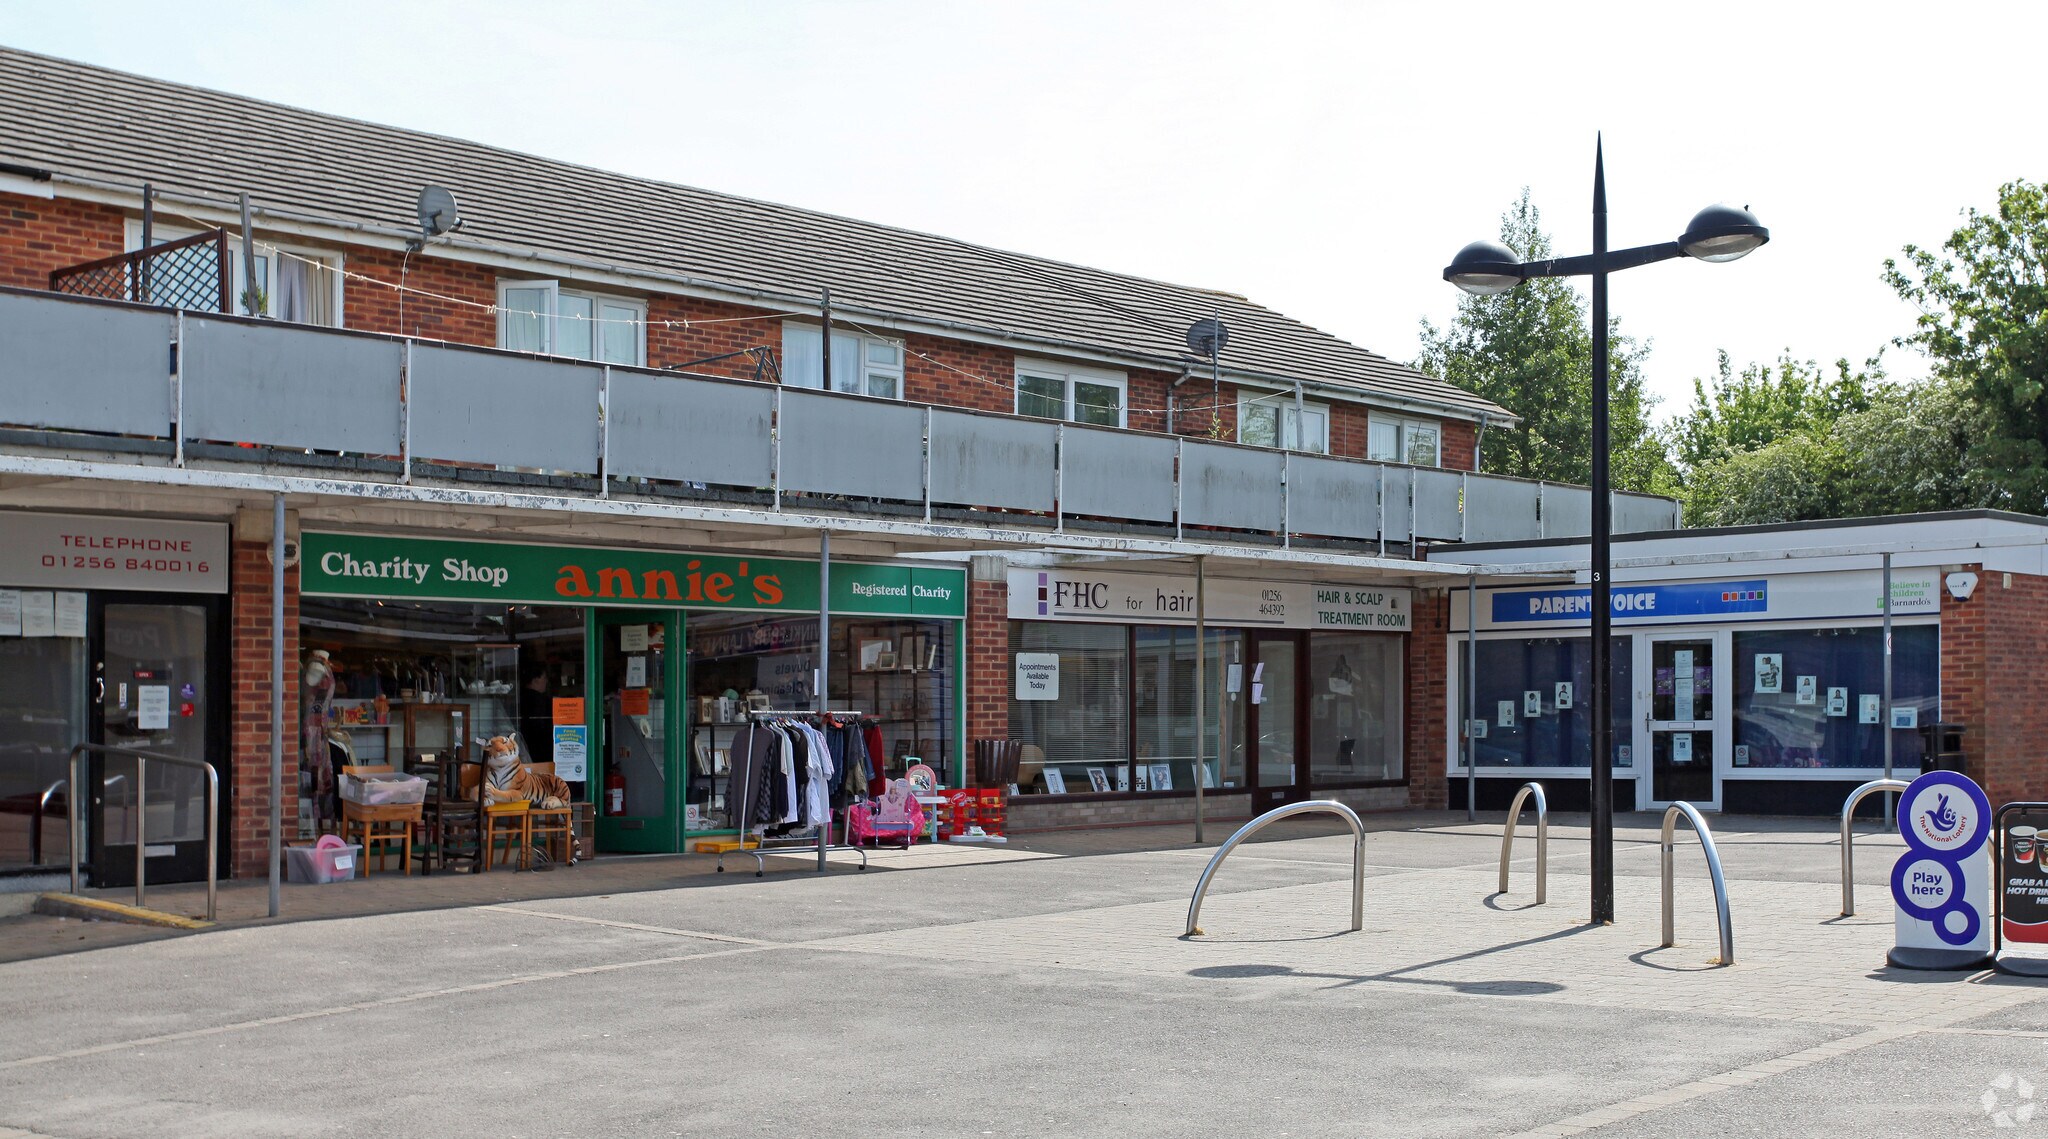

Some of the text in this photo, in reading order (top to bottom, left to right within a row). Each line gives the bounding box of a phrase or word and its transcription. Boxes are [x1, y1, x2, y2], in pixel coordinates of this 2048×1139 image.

[60, 534, 192, 552] TELEPHONE
[42, 555, 210, 574] 01256 840016
[320, 551, 508, 587] Charity Shop
[554, 560, 784, 605] annie's
[1593, 572, 1601, 582] 3
[1922, 580, 1931, 588] in
[852, 582, 951, 600] Registered Charity
[1053, 580, 1194, 612] FHC for hair
[1261, 589, 1282, 602] 01256
[1317, 590, 1384, 606] HAIR & SCALP
[1610, 592, 1656, 612] OICE
[1259, 603, 1285, 616] 464392
[1318, 611, 1406, 627] TREATMENT ROOM
[1019, 662, 1057, 671] Appointments
[1025, 672, 1050, 680] Available
[1030, 681, 1046, 691] Today
[1923, 827, 1953, 843] National
[1952, 815, 1967, 839] Lottery
[1913, 872, 1942, 886] Play
[2009, 878, 2036, 887] GRAB
[2034, 879, 2044, 887] A
[1911, 884, 1944, 896] here
[2006, 887, 2028, 895] HOT
